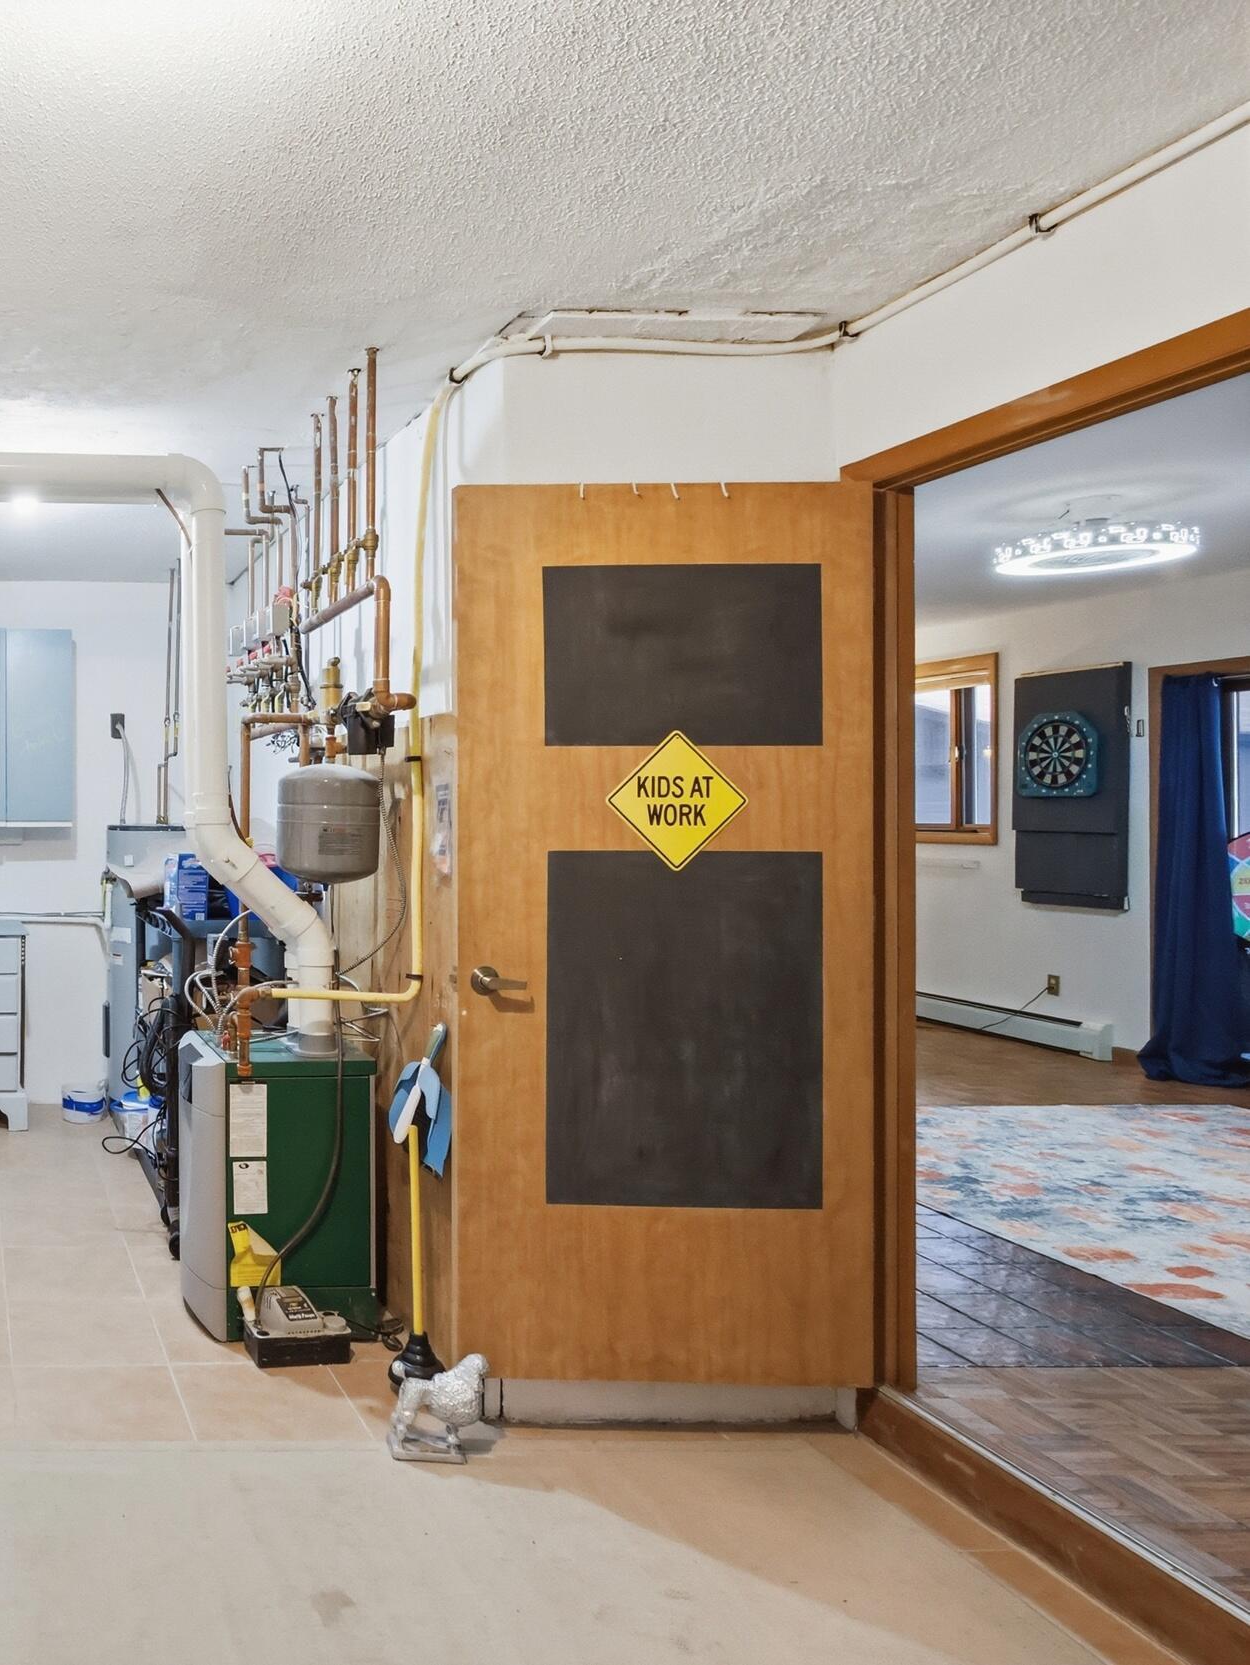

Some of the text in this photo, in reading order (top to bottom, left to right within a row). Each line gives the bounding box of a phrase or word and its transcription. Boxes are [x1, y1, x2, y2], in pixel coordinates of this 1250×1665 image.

[637, 775, 714, 798] KIDS AT
[647, 804, 706, 826] WORK
